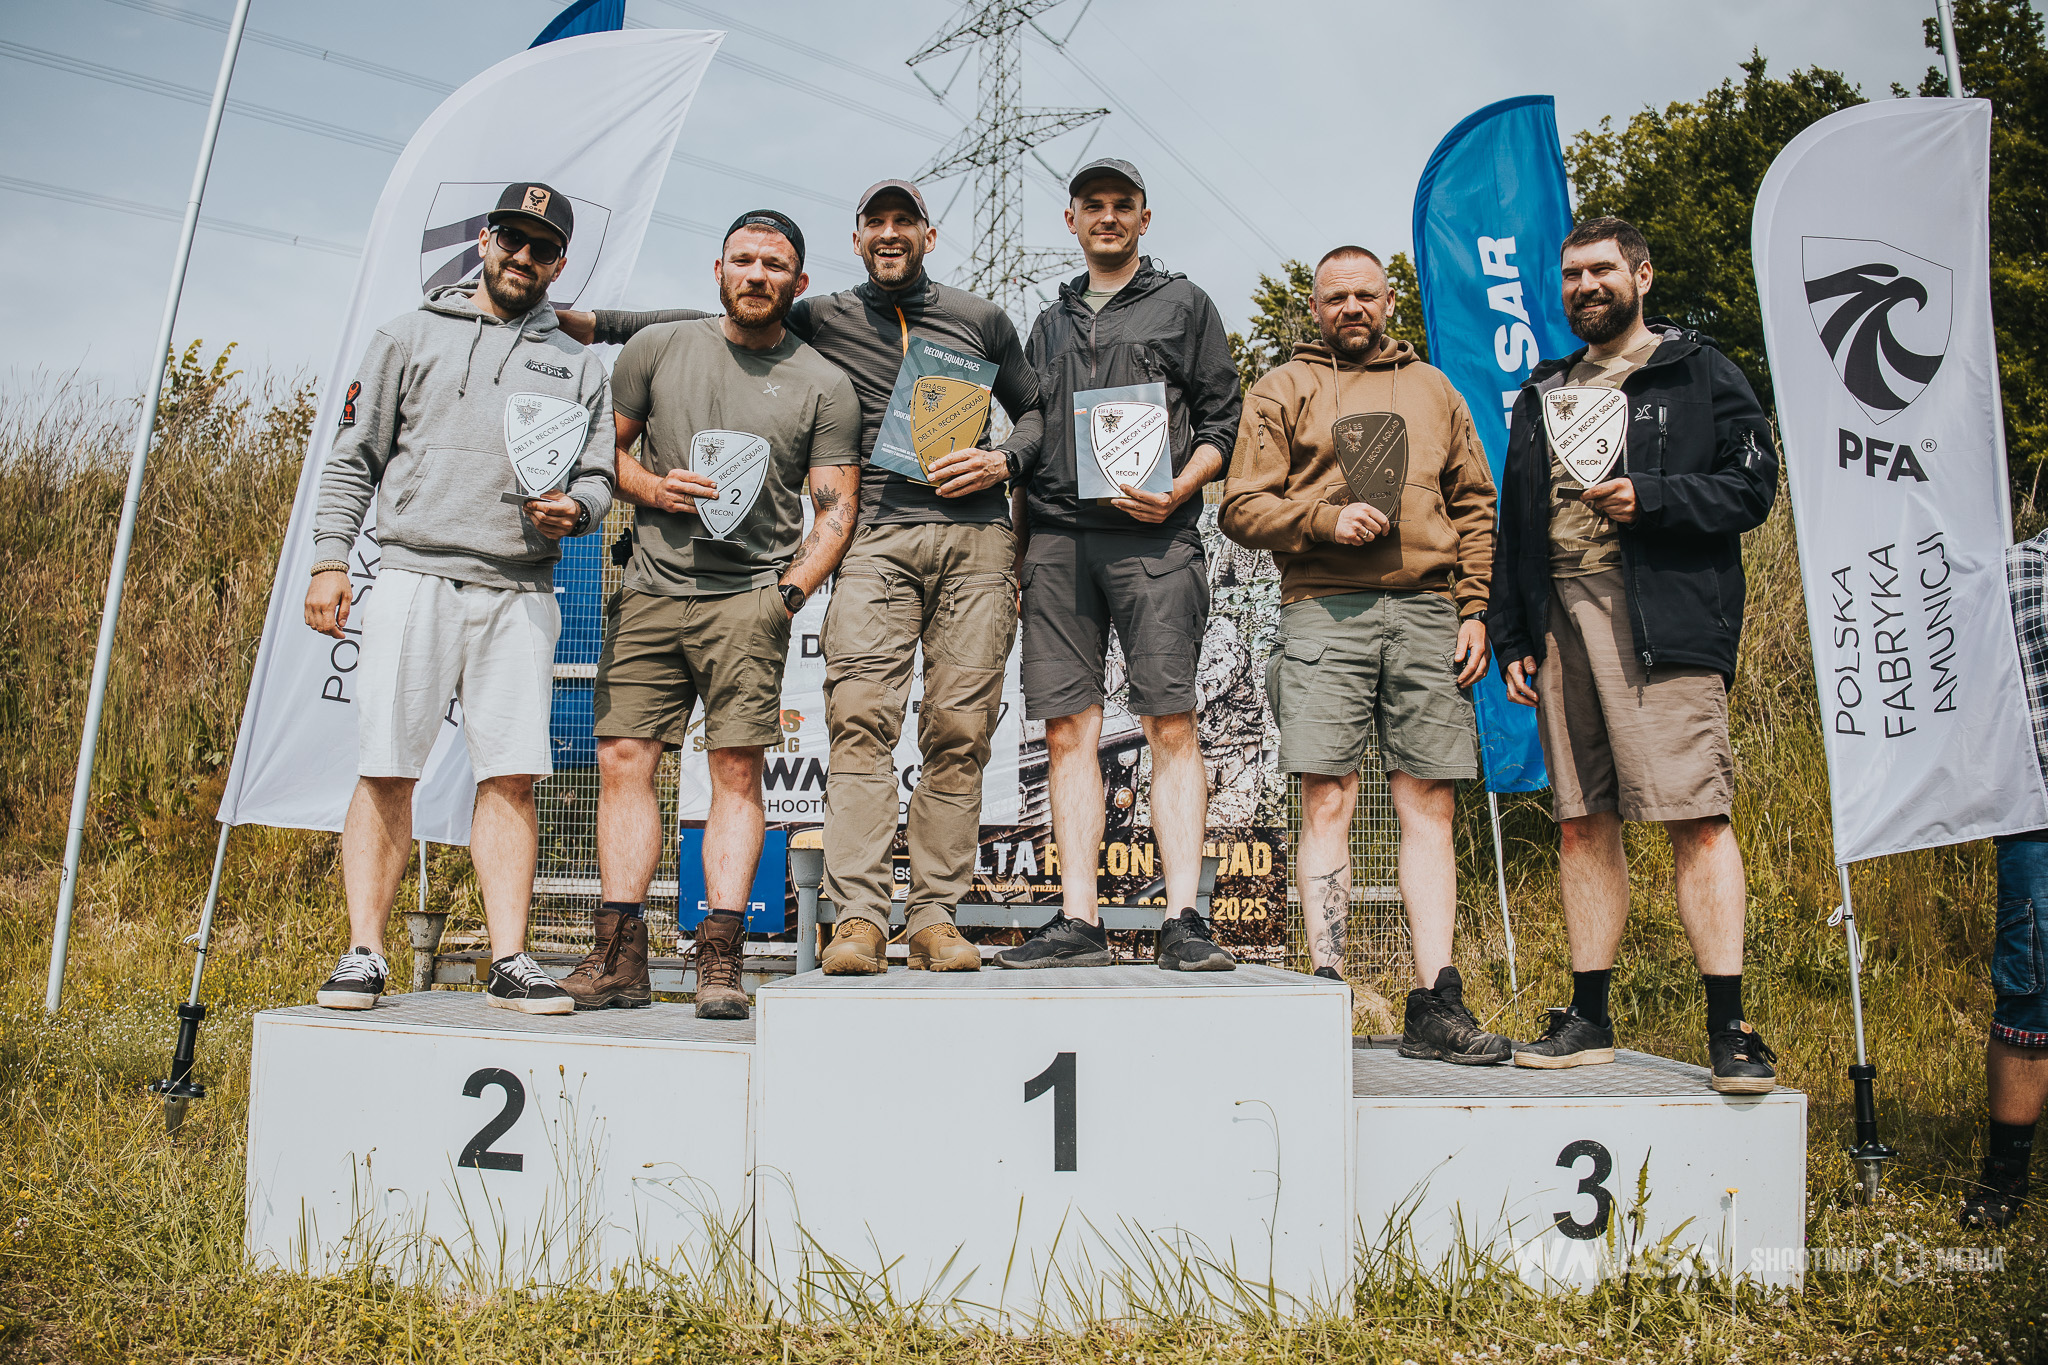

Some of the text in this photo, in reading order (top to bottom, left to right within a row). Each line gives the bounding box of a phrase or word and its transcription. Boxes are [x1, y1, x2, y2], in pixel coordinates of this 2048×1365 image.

[924, 346, 980, 372] RECON SQUAD 2025
[921, 382, 947, 393] BRASS
[513, 410, 583, 454] DELTA RECON SQUAD
[918, 394, 984, 442] DELTA RECON SQUAD
[1102, 412, 1162, 461] DELTA RECON SQUAD
[1559, 395, 1621, 450] DELTA RECON SQUAD
[547, 450, 560, 466] 2
[718, 444, 764, 481] RECON SQUAD
[1134, 452, 1140, 466] 1
[1353, 420, 1400, 484] DELTA RECON SQUAD
[1596, 438, 1608, 454] 3
[526, 466, 551, 476] RECON
[1384, 468, 1396, 486] 3
[710, 508, 734, 517] RECON
[730, 488, 742, 506] 2
[1369, 490, 1392, 500] RECON
[1868, 543, 1917, 739] FABRYKA
[1916, 531, 1958, 714] AMUNICJI
[1831, 565, 1866, 736] POLSKA
[1214, 896, 1268, 921] 2025
[458, 1067, 526, 1172] 2
[1024, 1052, 1078, 1172] 1
[1553, 1139, 1614, 1241] 3
